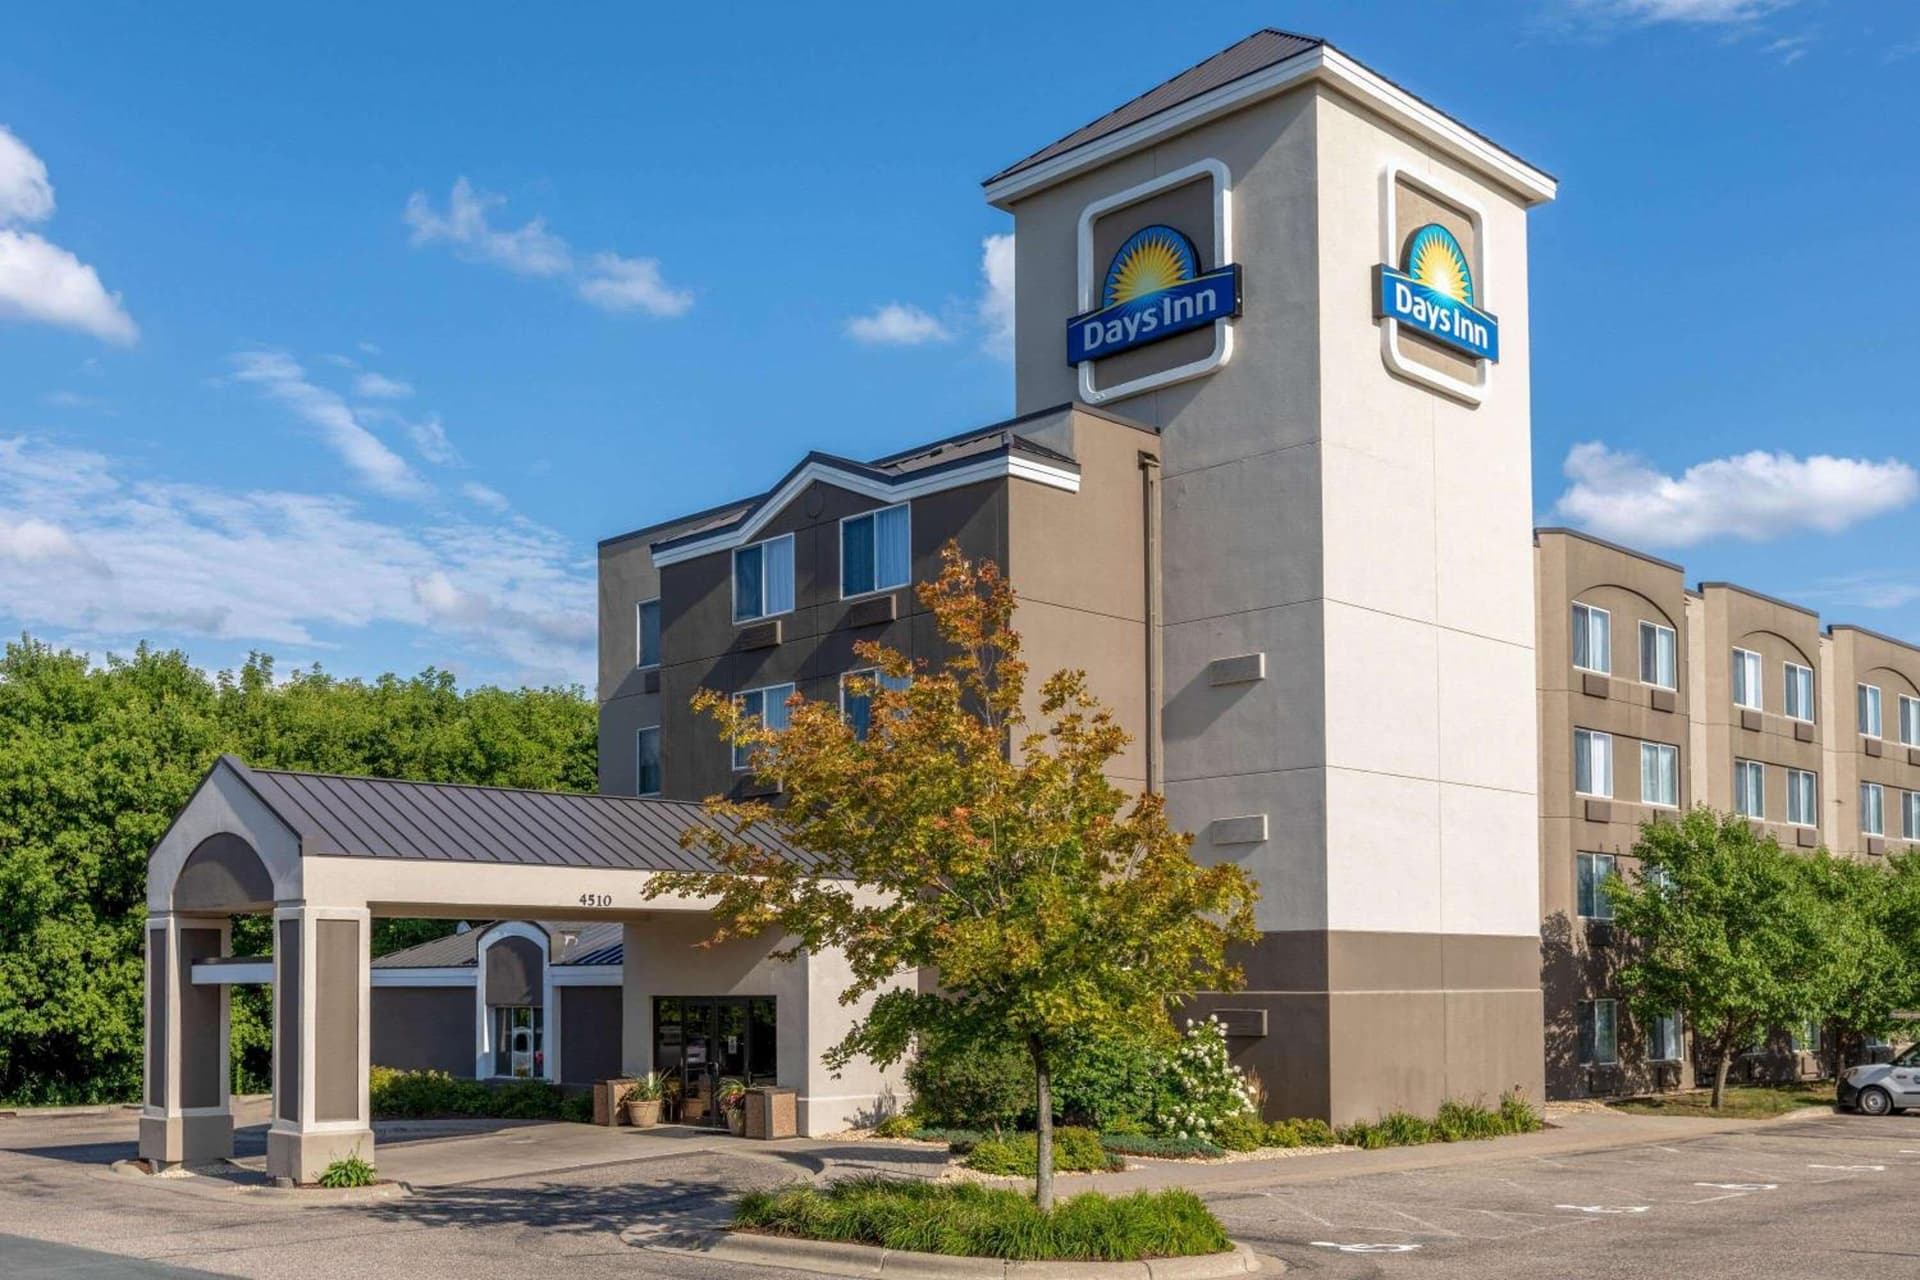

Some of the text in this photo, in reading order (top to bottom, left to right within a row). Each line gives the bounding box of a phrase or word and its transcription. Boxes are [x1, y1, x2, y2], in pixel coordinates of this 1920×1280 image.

[1084, 288, 1216, 351] Days Inn
[1395, 282, 1488, 349] Days Inn
[579, 893, 612, 907] 4510
